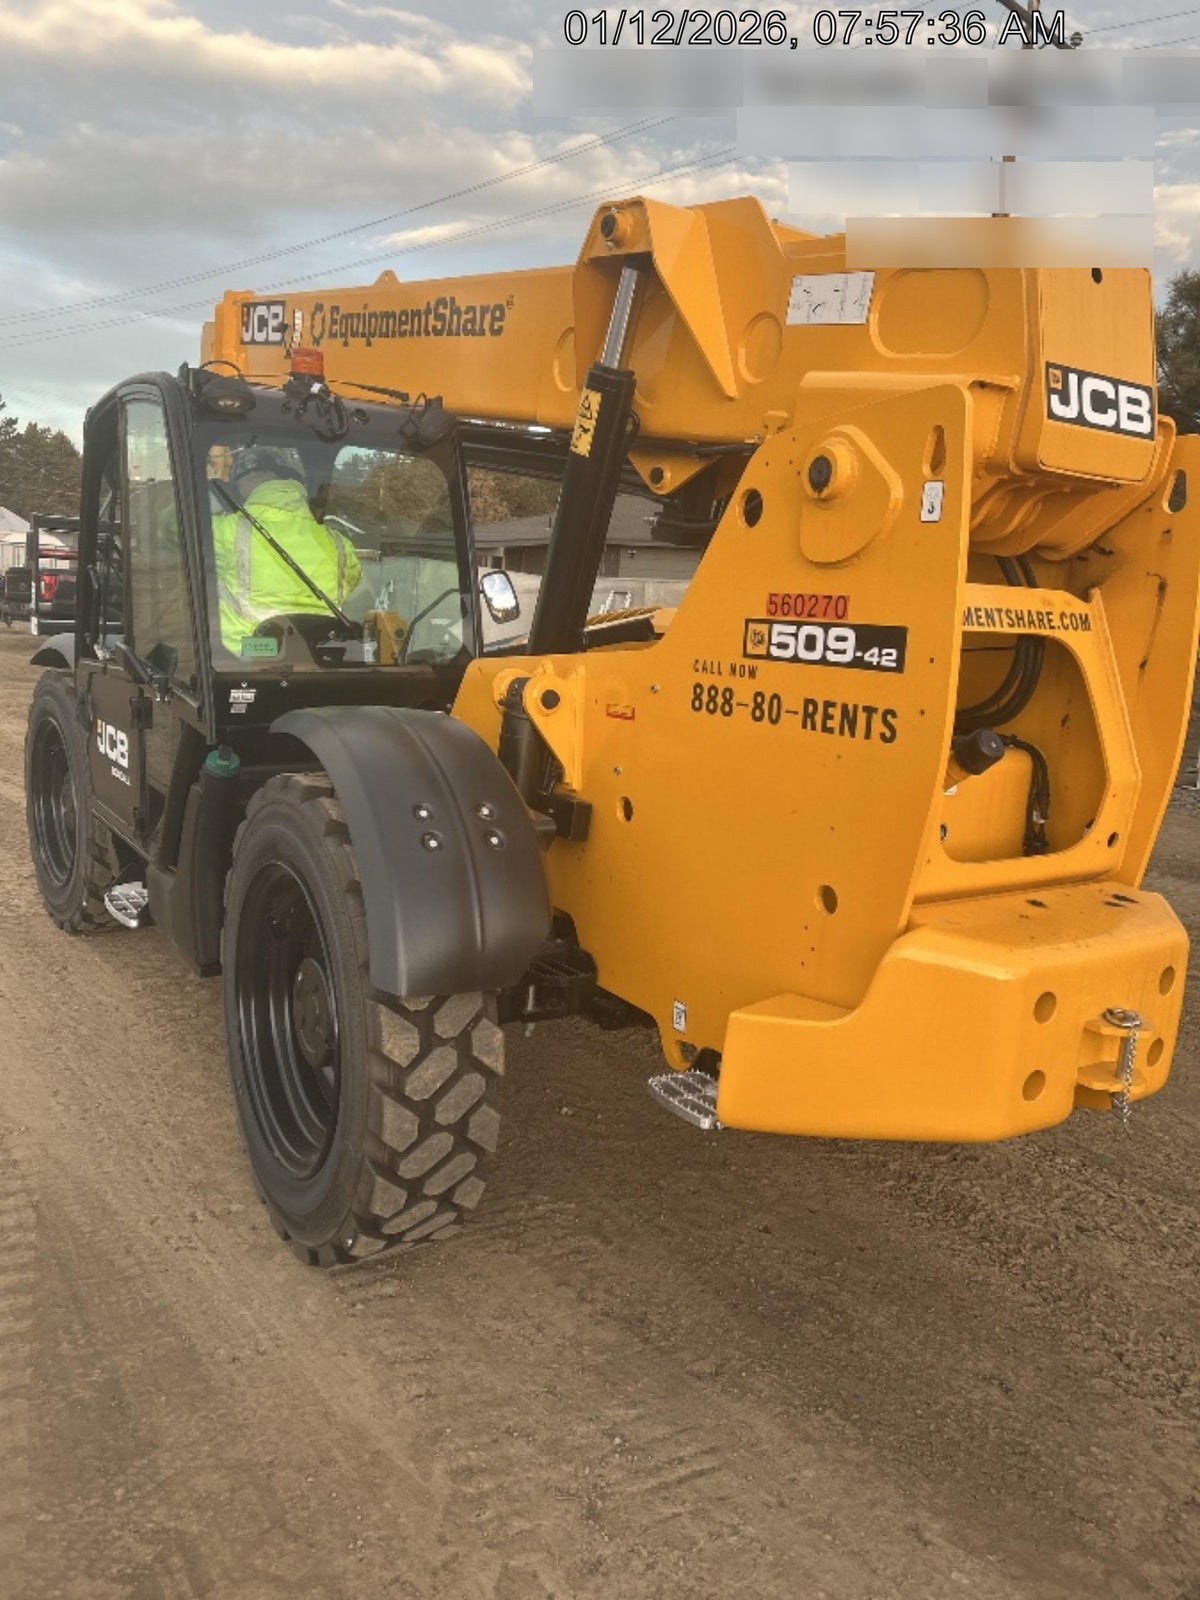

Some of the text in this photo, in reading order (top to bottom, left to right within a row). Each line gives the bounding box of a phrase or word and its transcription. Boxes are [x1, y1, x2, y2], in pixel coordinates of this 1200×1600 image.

[242, 305, 284, 343] JCB
[328, 296, 505, 346] EquipmentShare
[1049, 372, 1152, 434] JCB
[767, 593, 848, 620] 560270
[769, 625, 898, 668] 509-42
[692, 659, 758, 680] CALL NOW
[691, 682, 899, 744] 888-80-RENTS
[96, 720, 128, 768] JCB
